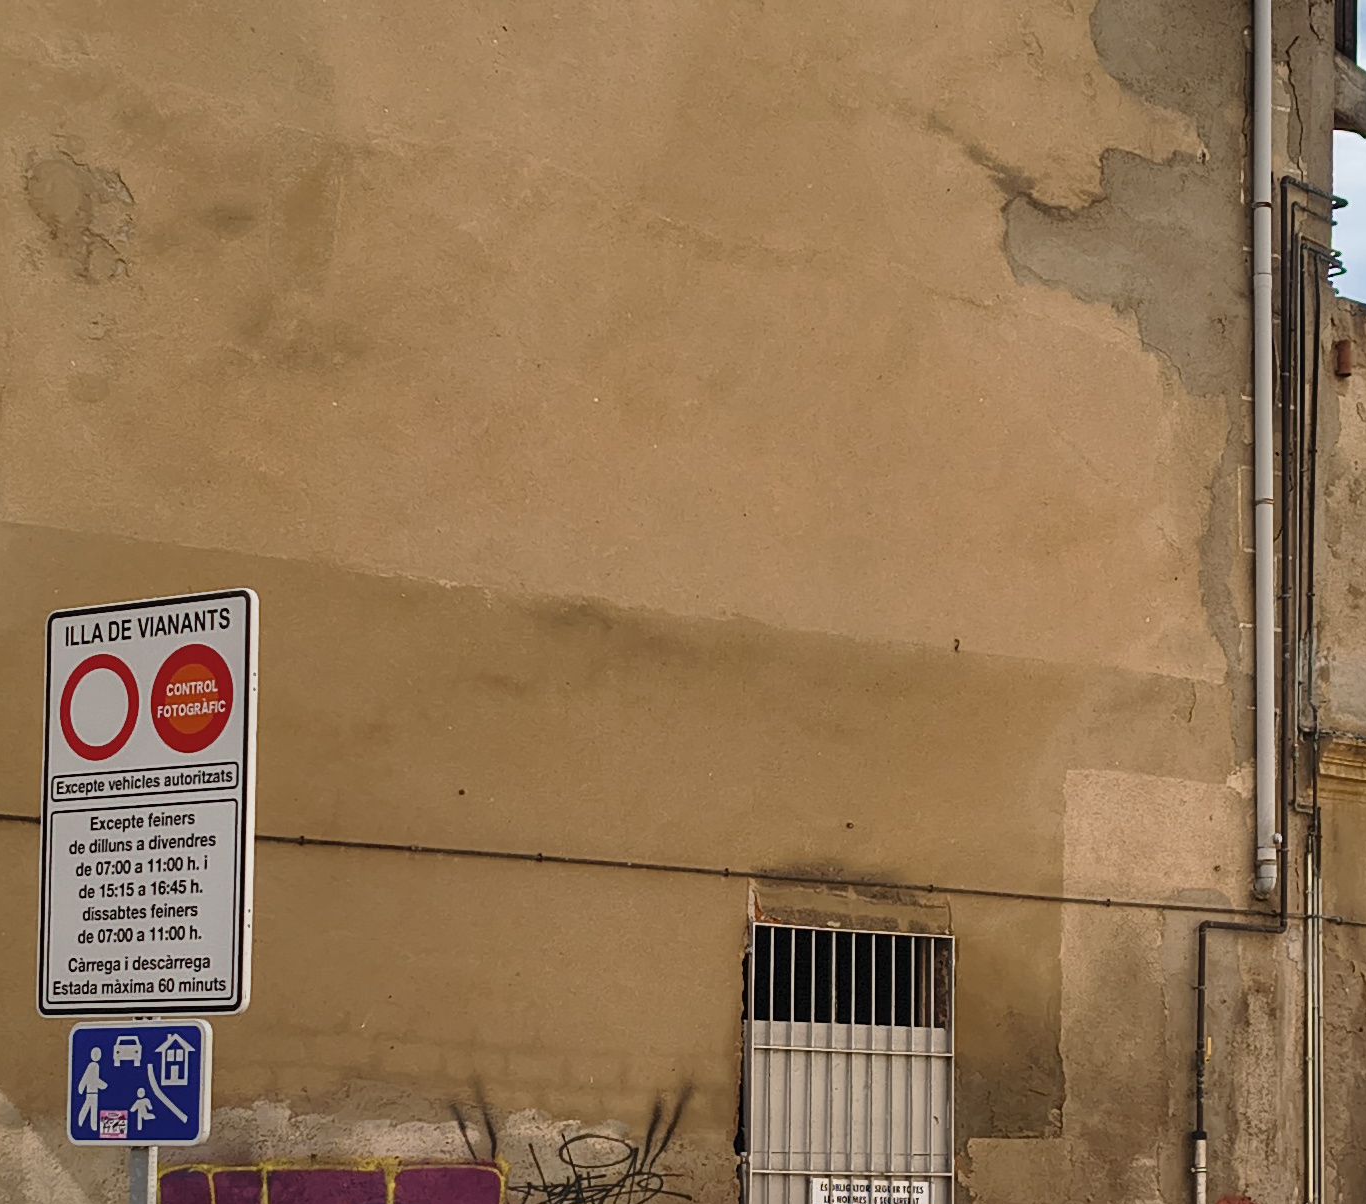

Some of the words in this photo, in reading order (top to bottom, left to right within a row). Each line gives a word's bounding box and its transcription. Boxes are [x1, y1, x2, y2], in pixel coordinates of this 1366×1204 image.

[65, 622, 104, 647] ILLA
[108, 619, 132, 642] DE
[138, 607, 231, 639] VIANANTS
[166, 679, 219, 697] CONTROL
[157, 697, 227, 719] FOTOGRÀFIC
[56, 780, 105, 795] Excepte
[109, 775, 160, 791] vehicles
[164, 770, 233, 786] autoritzats
[90, 814, 144, 832] Excepte
[149, 812, 196, 828] feiners
[69, 840, 85, 855] de
[89, 838, 133, 854] dilluns
[137, 840, 144, 851] a
[149, 833, 216, 850] divendres
[76, 862, 92, 877] de
[96, 859, 131, 876] 07:00
[135, 862, 143, 873] a
[148, 857, 183, 873] 11:00
[187, 856, 199, 871] h.
[204, 855, 208, 870] i
[79, 884, 95, 899] de
[99, 882, 134, 898] 15:15
[138, 885, 146, 897] a
[150, 880, 186, 895] 16:45
[190, 879, 203, 894] h.
[82, 906, 147, 921] dissabtes
[151, 903, 198, 918] feiners
[77, 929, 94, 944] de
[97, 927, 133, 943] 07:00
[137, 930, 145, 942] a
[150, 925, 185, 941] 11:00
[189, 925, 202, 940] h.
[68, 957, 121, 974] Càrrega
[125, 956, 128, 971] i
[133, 954, 211, 972] descàrrega
[53, 980, 97, 995] Estada
[101, 979, 154, 995] màxima
[158, 978, 175, 993] 60
[178, 977, 226, 993] minuts
[824, 1195, 834, 1204] LE
